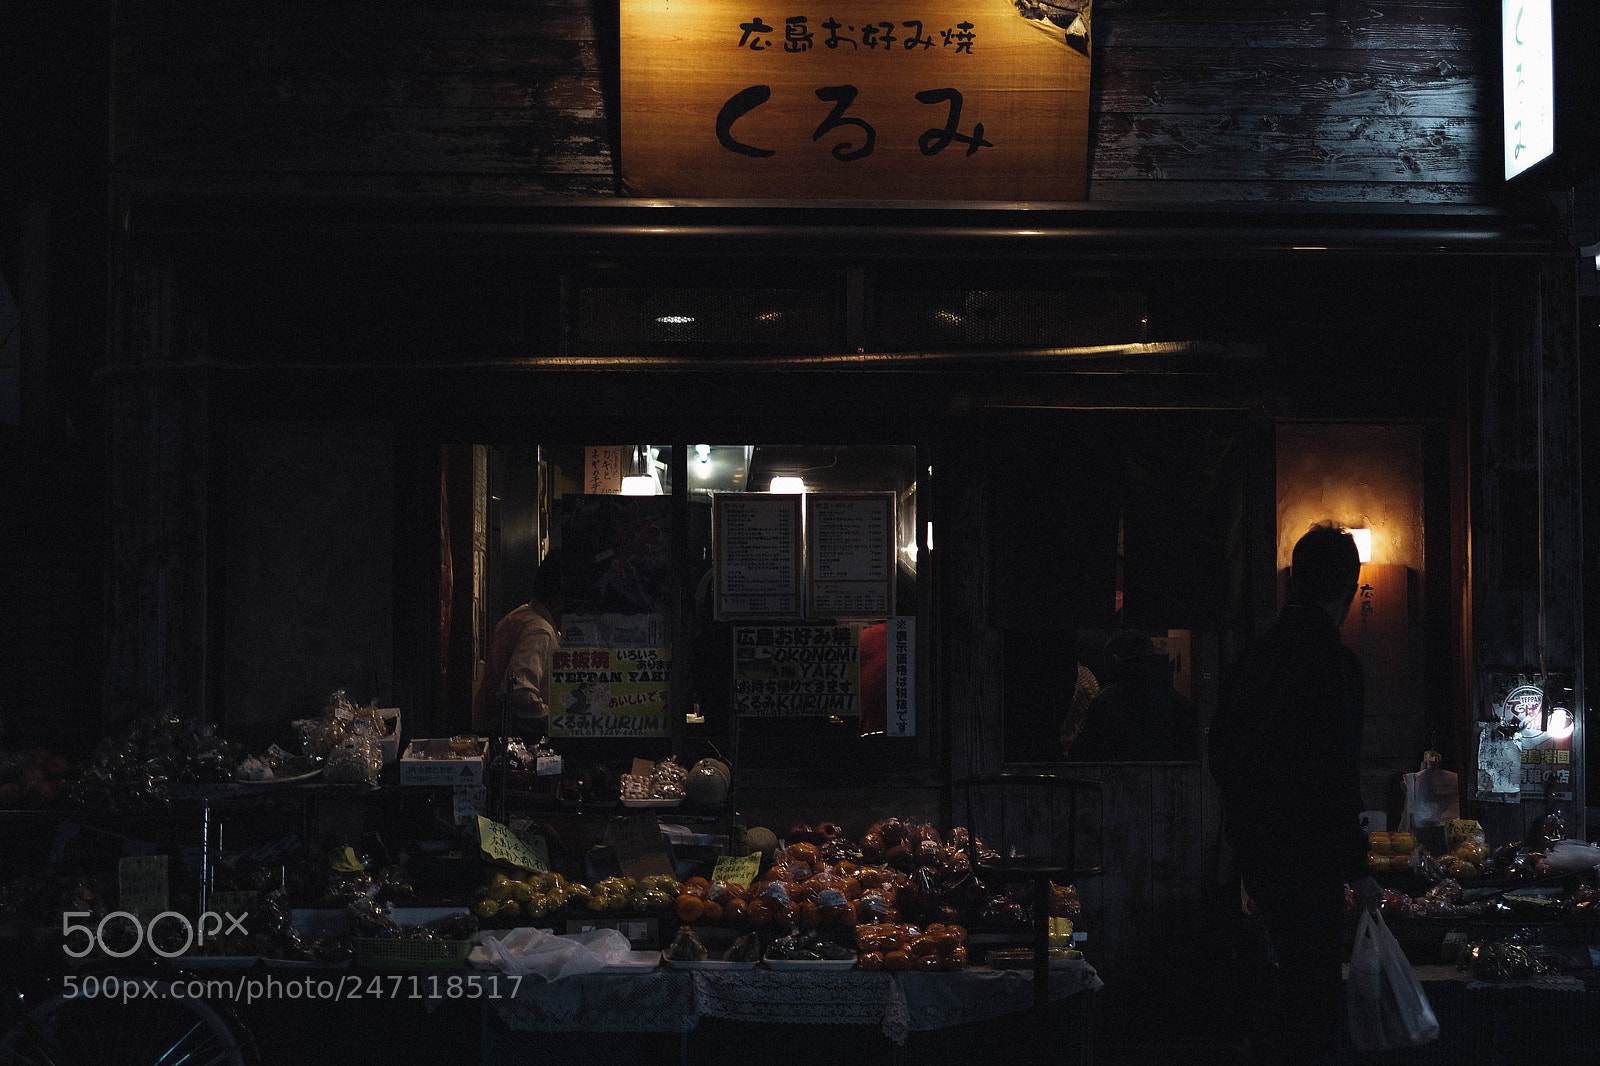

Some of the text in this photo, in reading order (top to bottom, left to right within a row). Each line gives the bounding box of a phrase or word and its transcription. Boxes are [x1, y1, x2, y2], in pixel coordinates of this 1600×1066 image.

[738, 16, 977, 55] 広島お好み焼
[715, 84, 994, 162] くるみ
[737, 628, 851, 646] 広島お好み焼
[552, 650, 658, 669] 鉄板焼 いろいろ
[774, 647, 857, 662] OKONOMI
[552, 672, 672, 683] TEPPAN YAKI
[800, 663, 846, 678] YAKI
[609, 690, 668, 708] おいしいです
[1508, 701, 1543, 718] てっぱ
